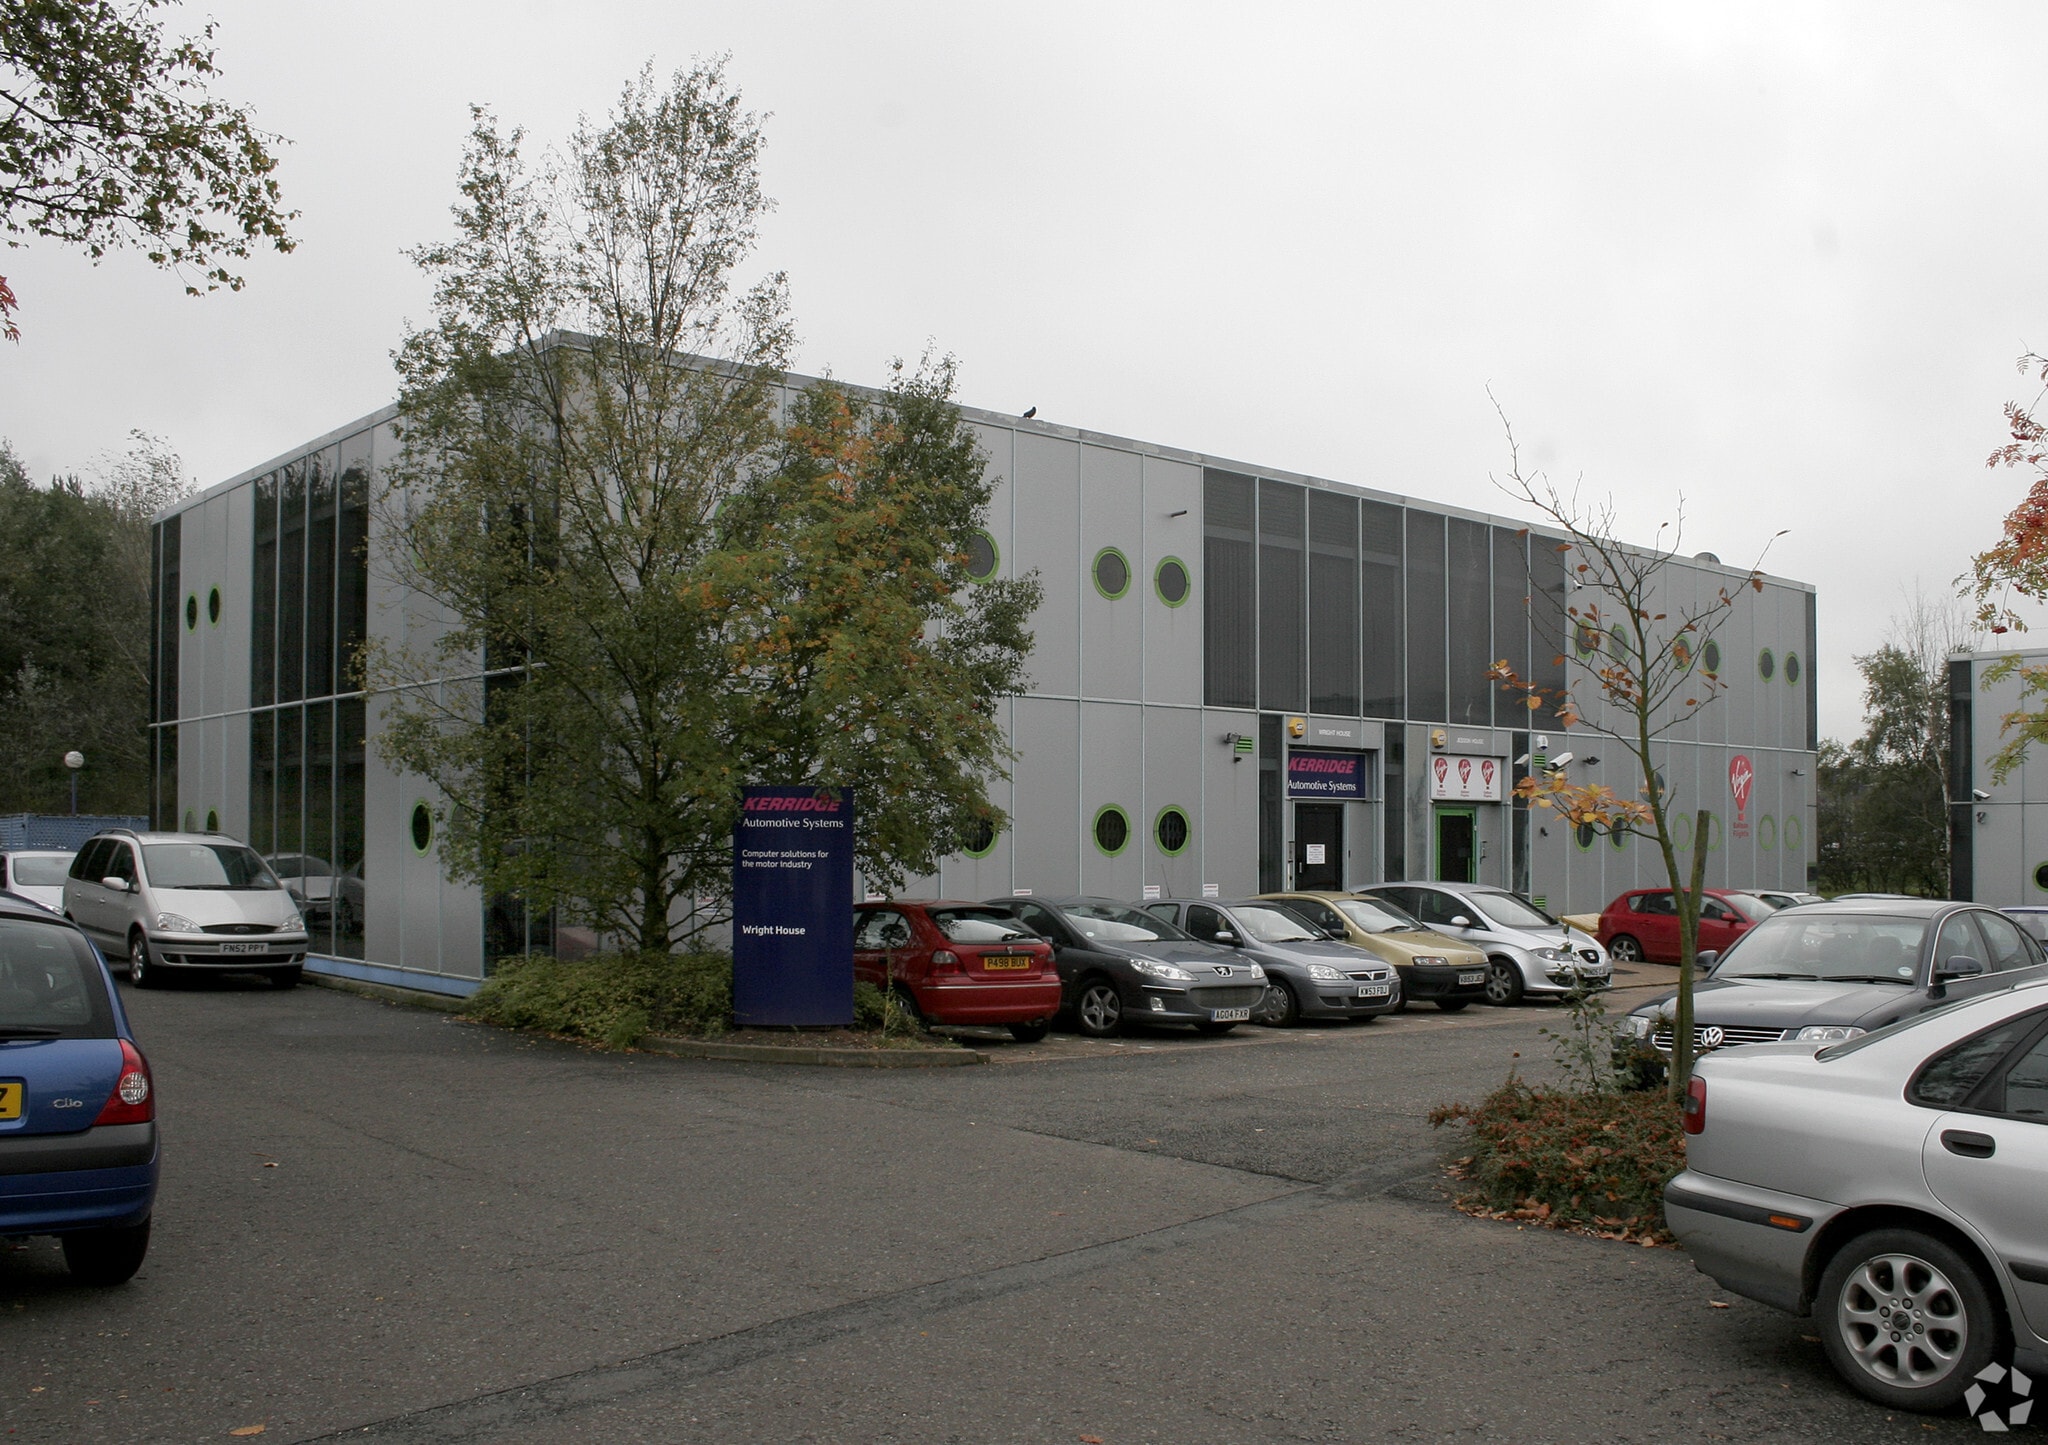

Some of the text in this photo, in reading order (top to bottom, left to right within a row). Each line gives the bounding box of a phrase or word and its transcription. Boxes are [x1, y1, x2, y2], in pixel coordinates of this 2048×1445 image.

[1336, 730, 1352, 738] HOUSE
[1289, 757, 1357, 774] KERRIDGE
[1287, 779, 1357, 794] Automotive Systems
[743, 797, 842, 812] KERRIDGE
[742, 817, 844, 831] Automotive Systems
[742, 849, 830, 861] Computer solutions for
[742, 860, 755, 868] the
[780, 860, 813, 870] industry
[742, 925, 806, 937] Wright House
[223, 944, 265, 953] FN52 PPY
[987, 958, 1026, 968] P498 BUX
[1216, 1009, 1234, 1020] AG04
[53, 1098, 84, 1109] Clio
